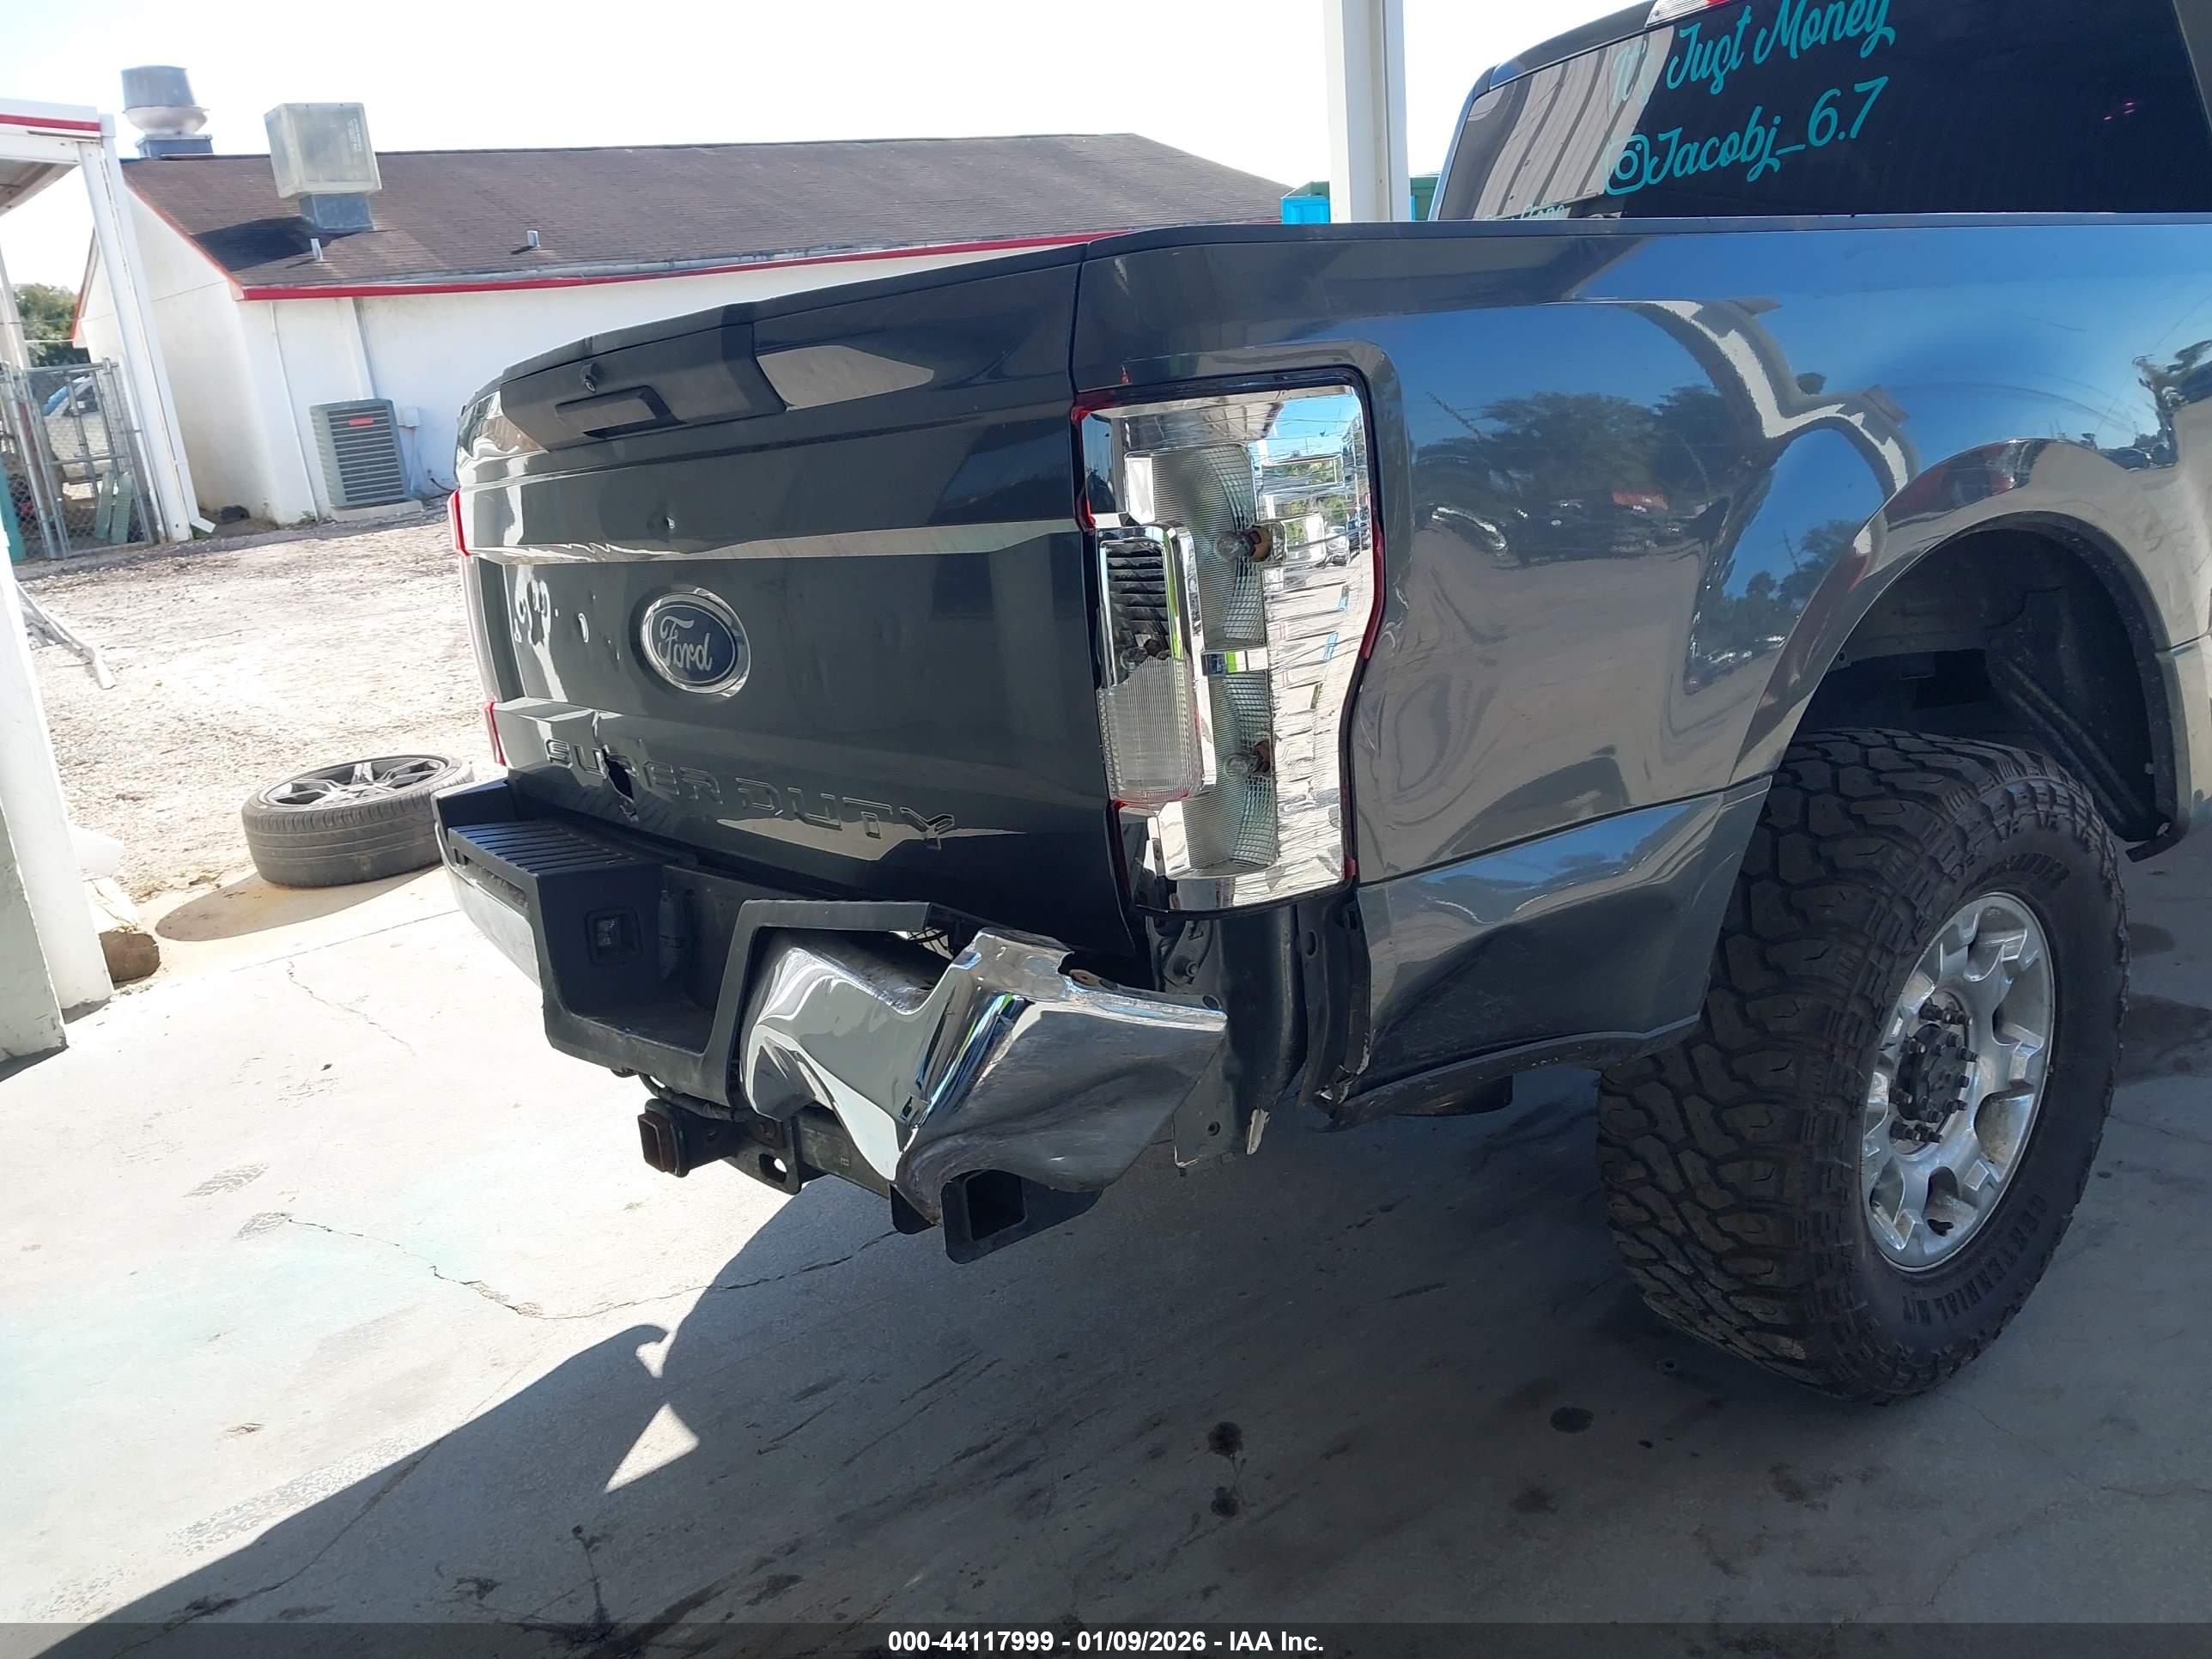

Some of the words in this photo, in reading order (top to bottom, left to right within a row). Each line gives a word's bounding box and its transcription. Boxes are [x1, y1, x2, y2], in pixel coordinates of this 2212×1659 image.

[1666, 5, 1752, 95] Just
[1753, 0, 1896, 64] Money
[659, 615, 714, 671] Ford
[735, 777, 955, 851] DUTY
